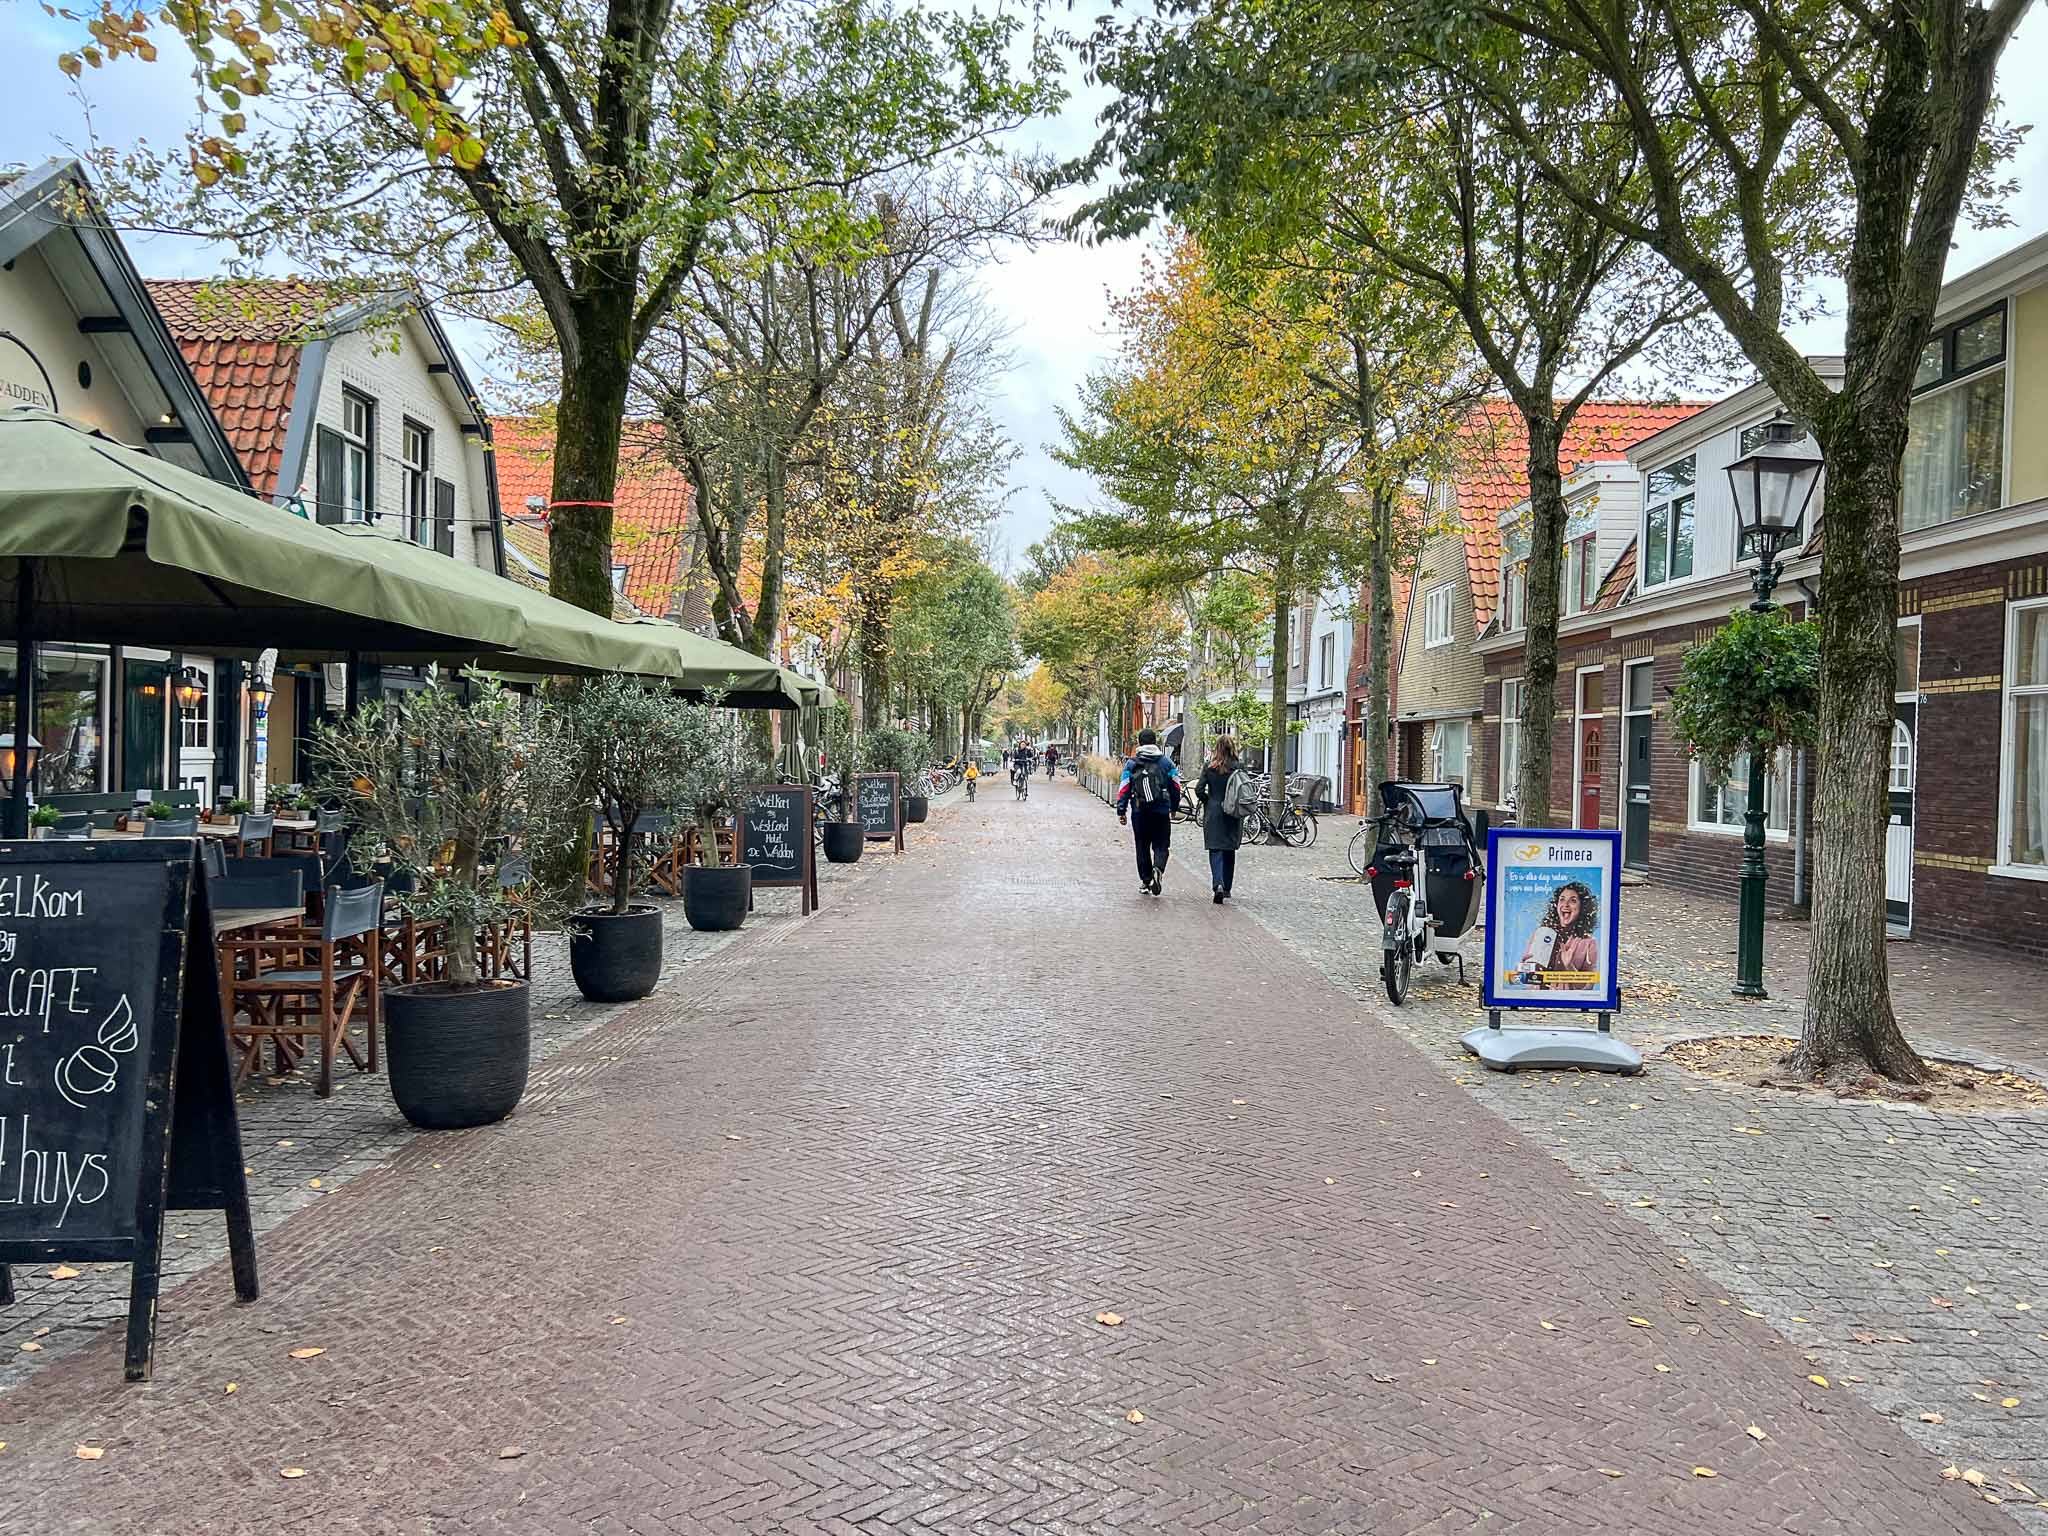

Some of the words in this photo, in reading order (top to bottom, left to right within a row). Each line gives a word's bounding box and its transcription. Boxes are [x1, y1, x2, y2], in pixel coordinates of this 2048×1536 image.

[0, 383, 49, 407] ADDEN
[1548, 846, 1592, 861] Primera
[0, 873, 85, 918] ELKOM
[0, 966, 97, 1033] CAFE
